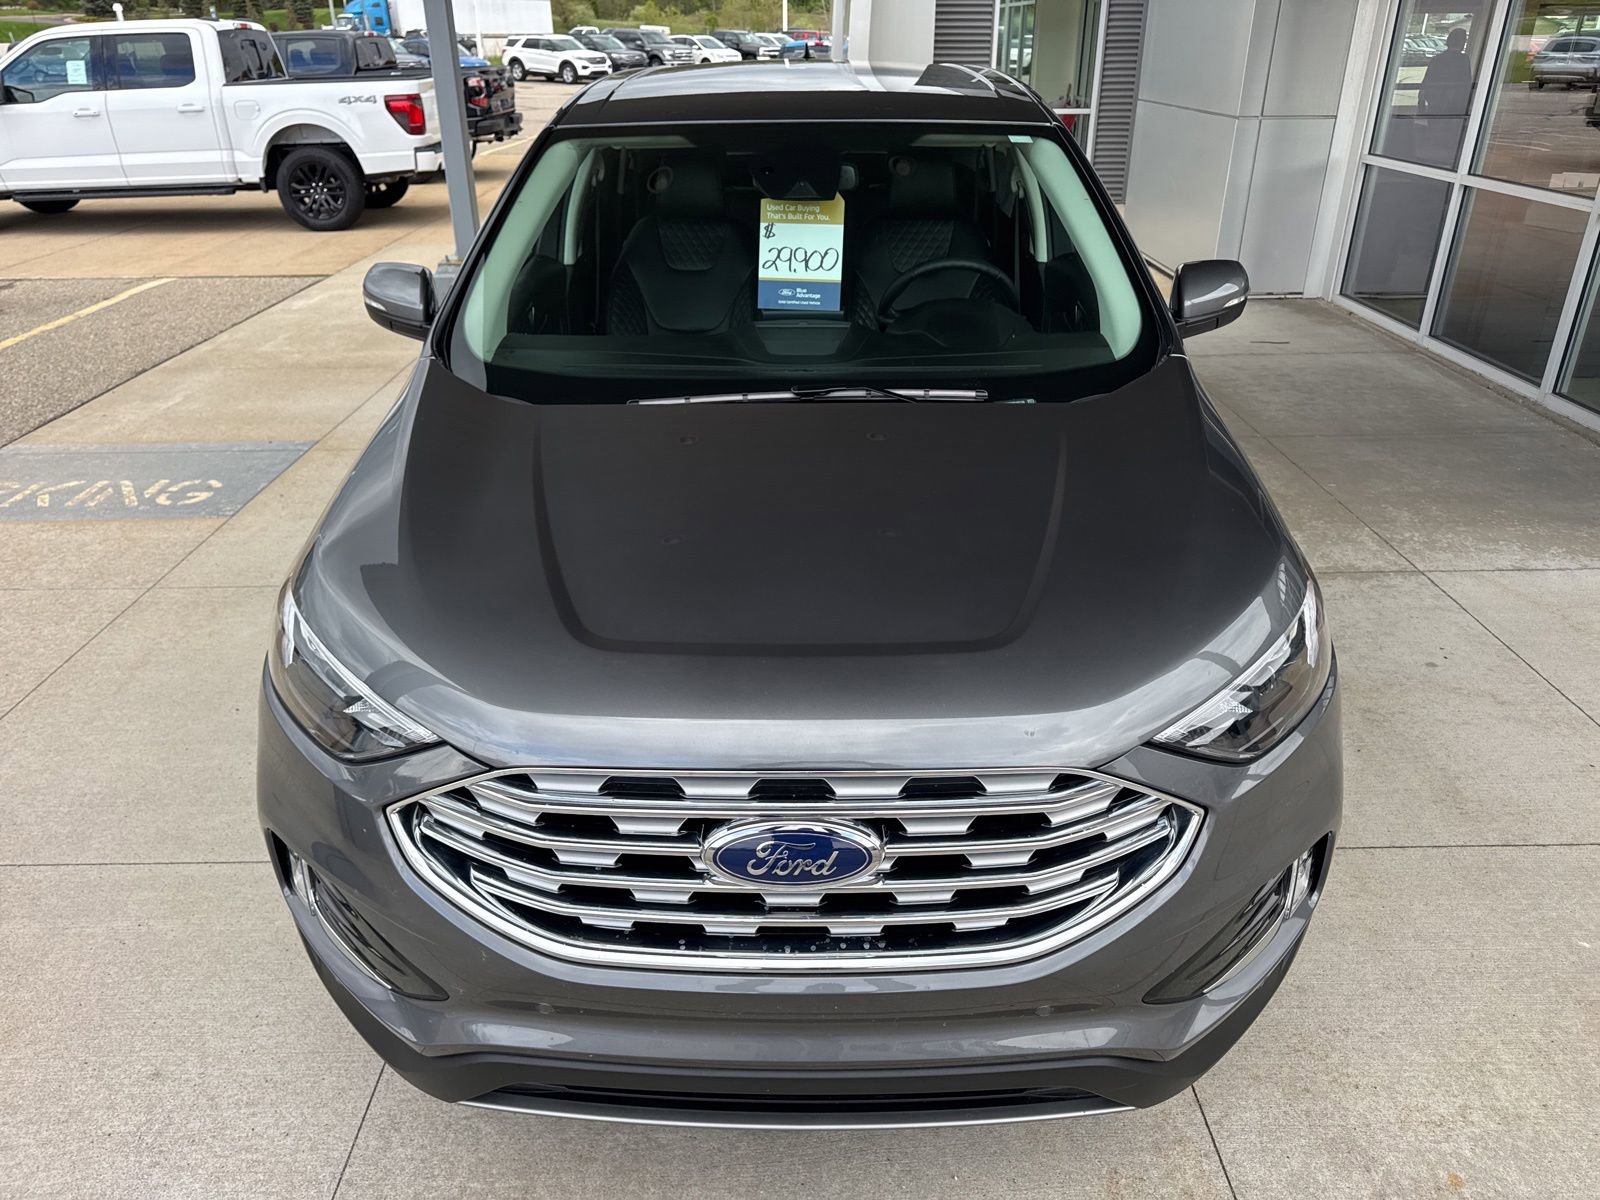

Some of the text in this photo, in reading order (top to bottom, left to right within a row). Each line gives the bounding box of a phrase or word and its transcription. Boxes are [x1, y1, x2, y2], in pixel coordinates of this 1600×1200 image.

[766, 203, 784, 211] Used
[797, 205, 820, 213] Buying
[767, 212, 786, 220] That's
[763, 222, 776, 239] $
[746, 840, 840, 876] Ford
